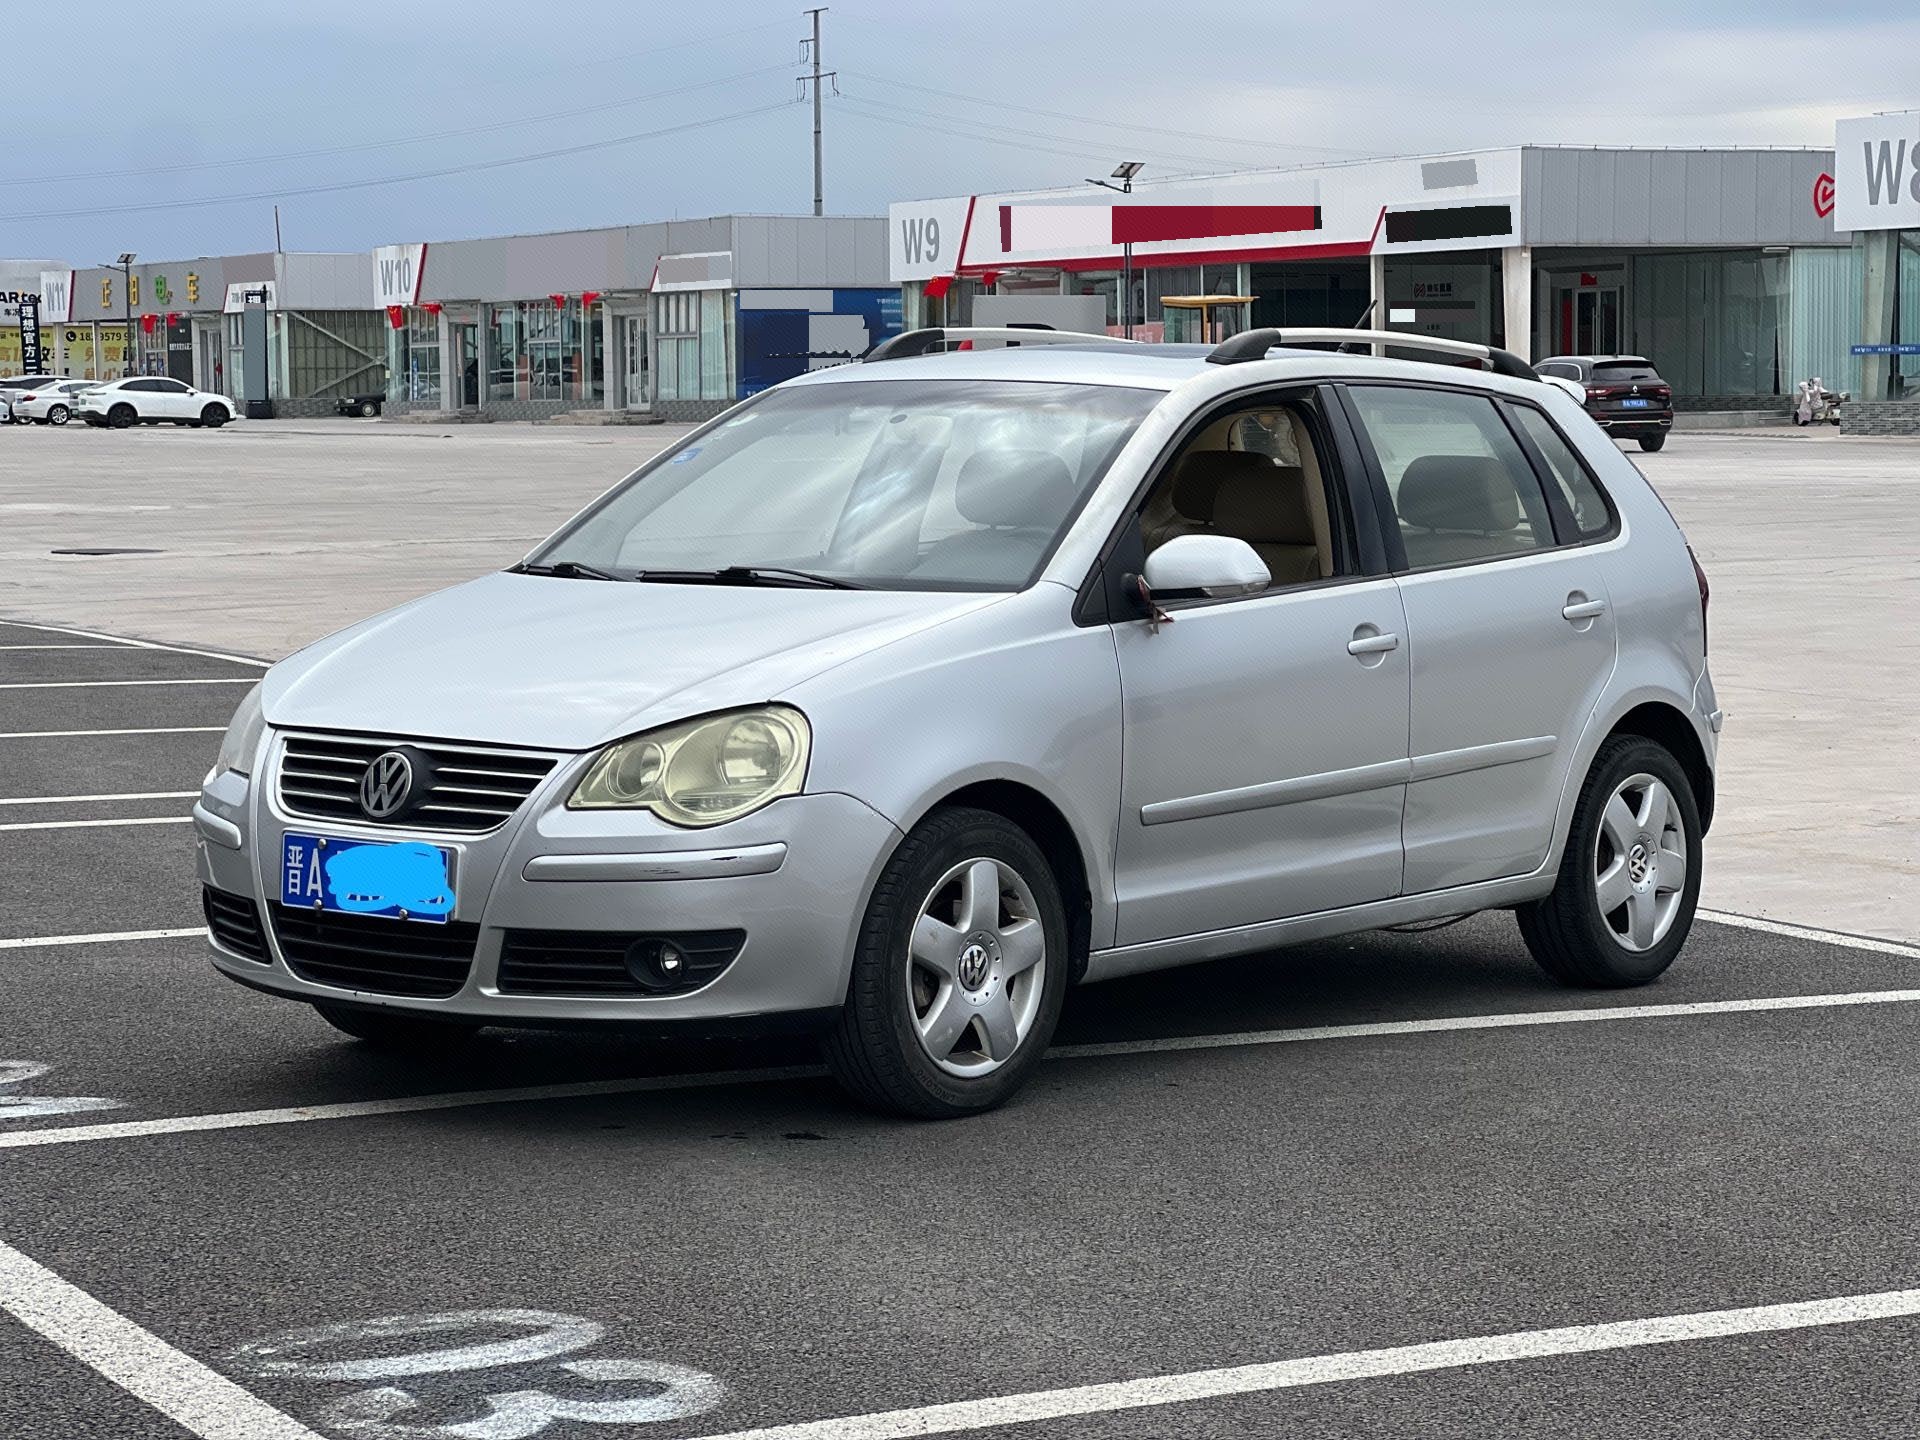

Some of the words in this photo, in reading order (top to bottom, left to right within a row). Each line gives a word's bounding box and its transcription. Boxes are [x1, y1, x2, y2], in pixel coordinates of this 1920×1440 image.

[902, 217, 940, 264] W9
[380, 257, 411, 295] W10
[46, 282, 66, 311] W11
